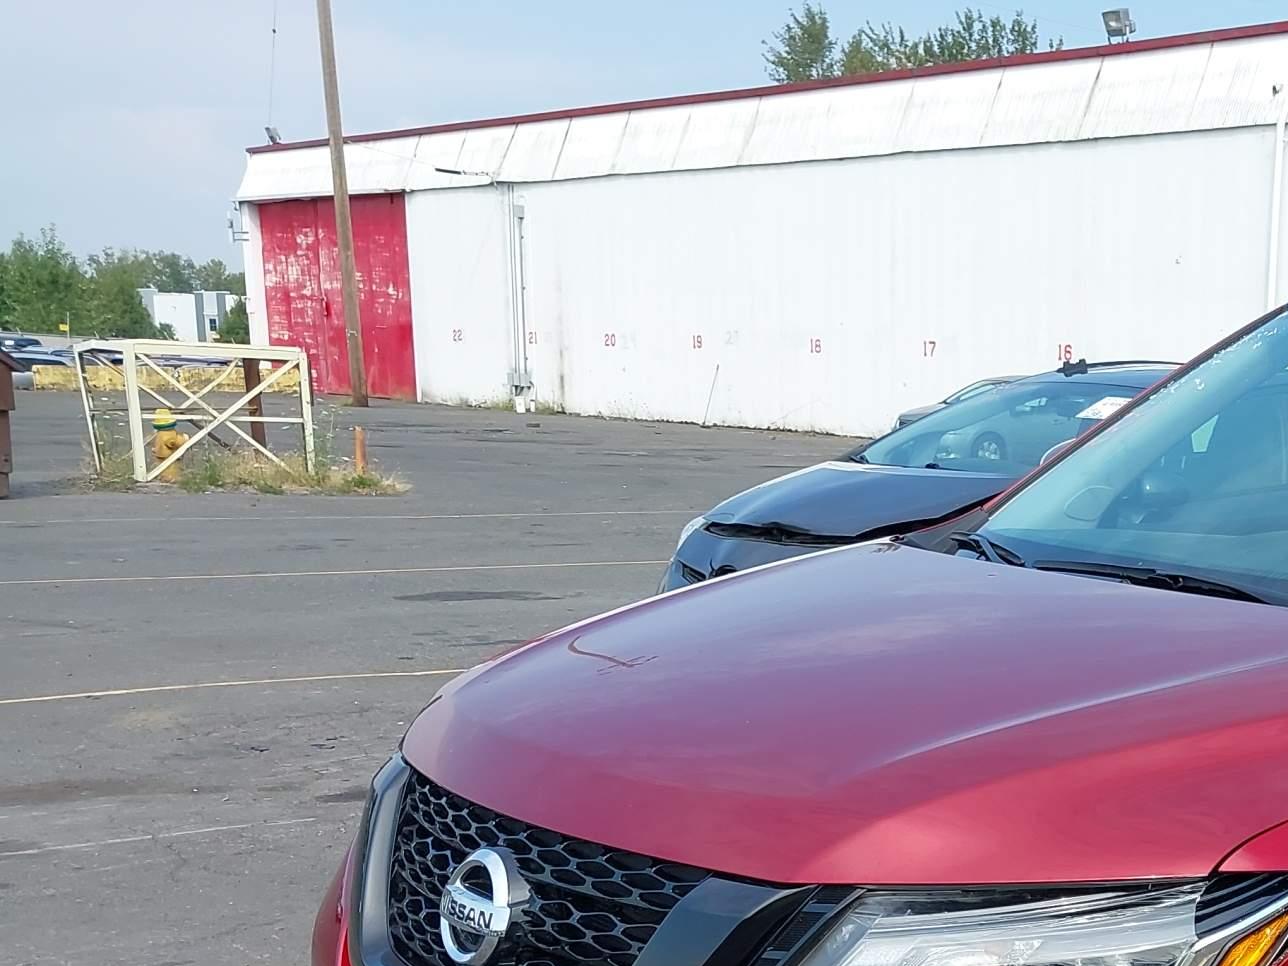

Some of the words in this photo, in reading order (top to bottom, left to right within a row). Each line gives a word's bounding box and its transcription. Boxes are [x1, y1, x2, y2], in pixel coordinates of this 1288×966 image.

[452, 328, 463, 342] 22
[528, 331, 538, 344] 21
[604, 333, 616, 347] 20
[692, 335, 703, 349] 19
[810, 338, 822, 354] 18
[923, 340, 936, 357] 17
[1057, 343, 1073, 361] 16
[441, 892, 494, 929] NISSAN
